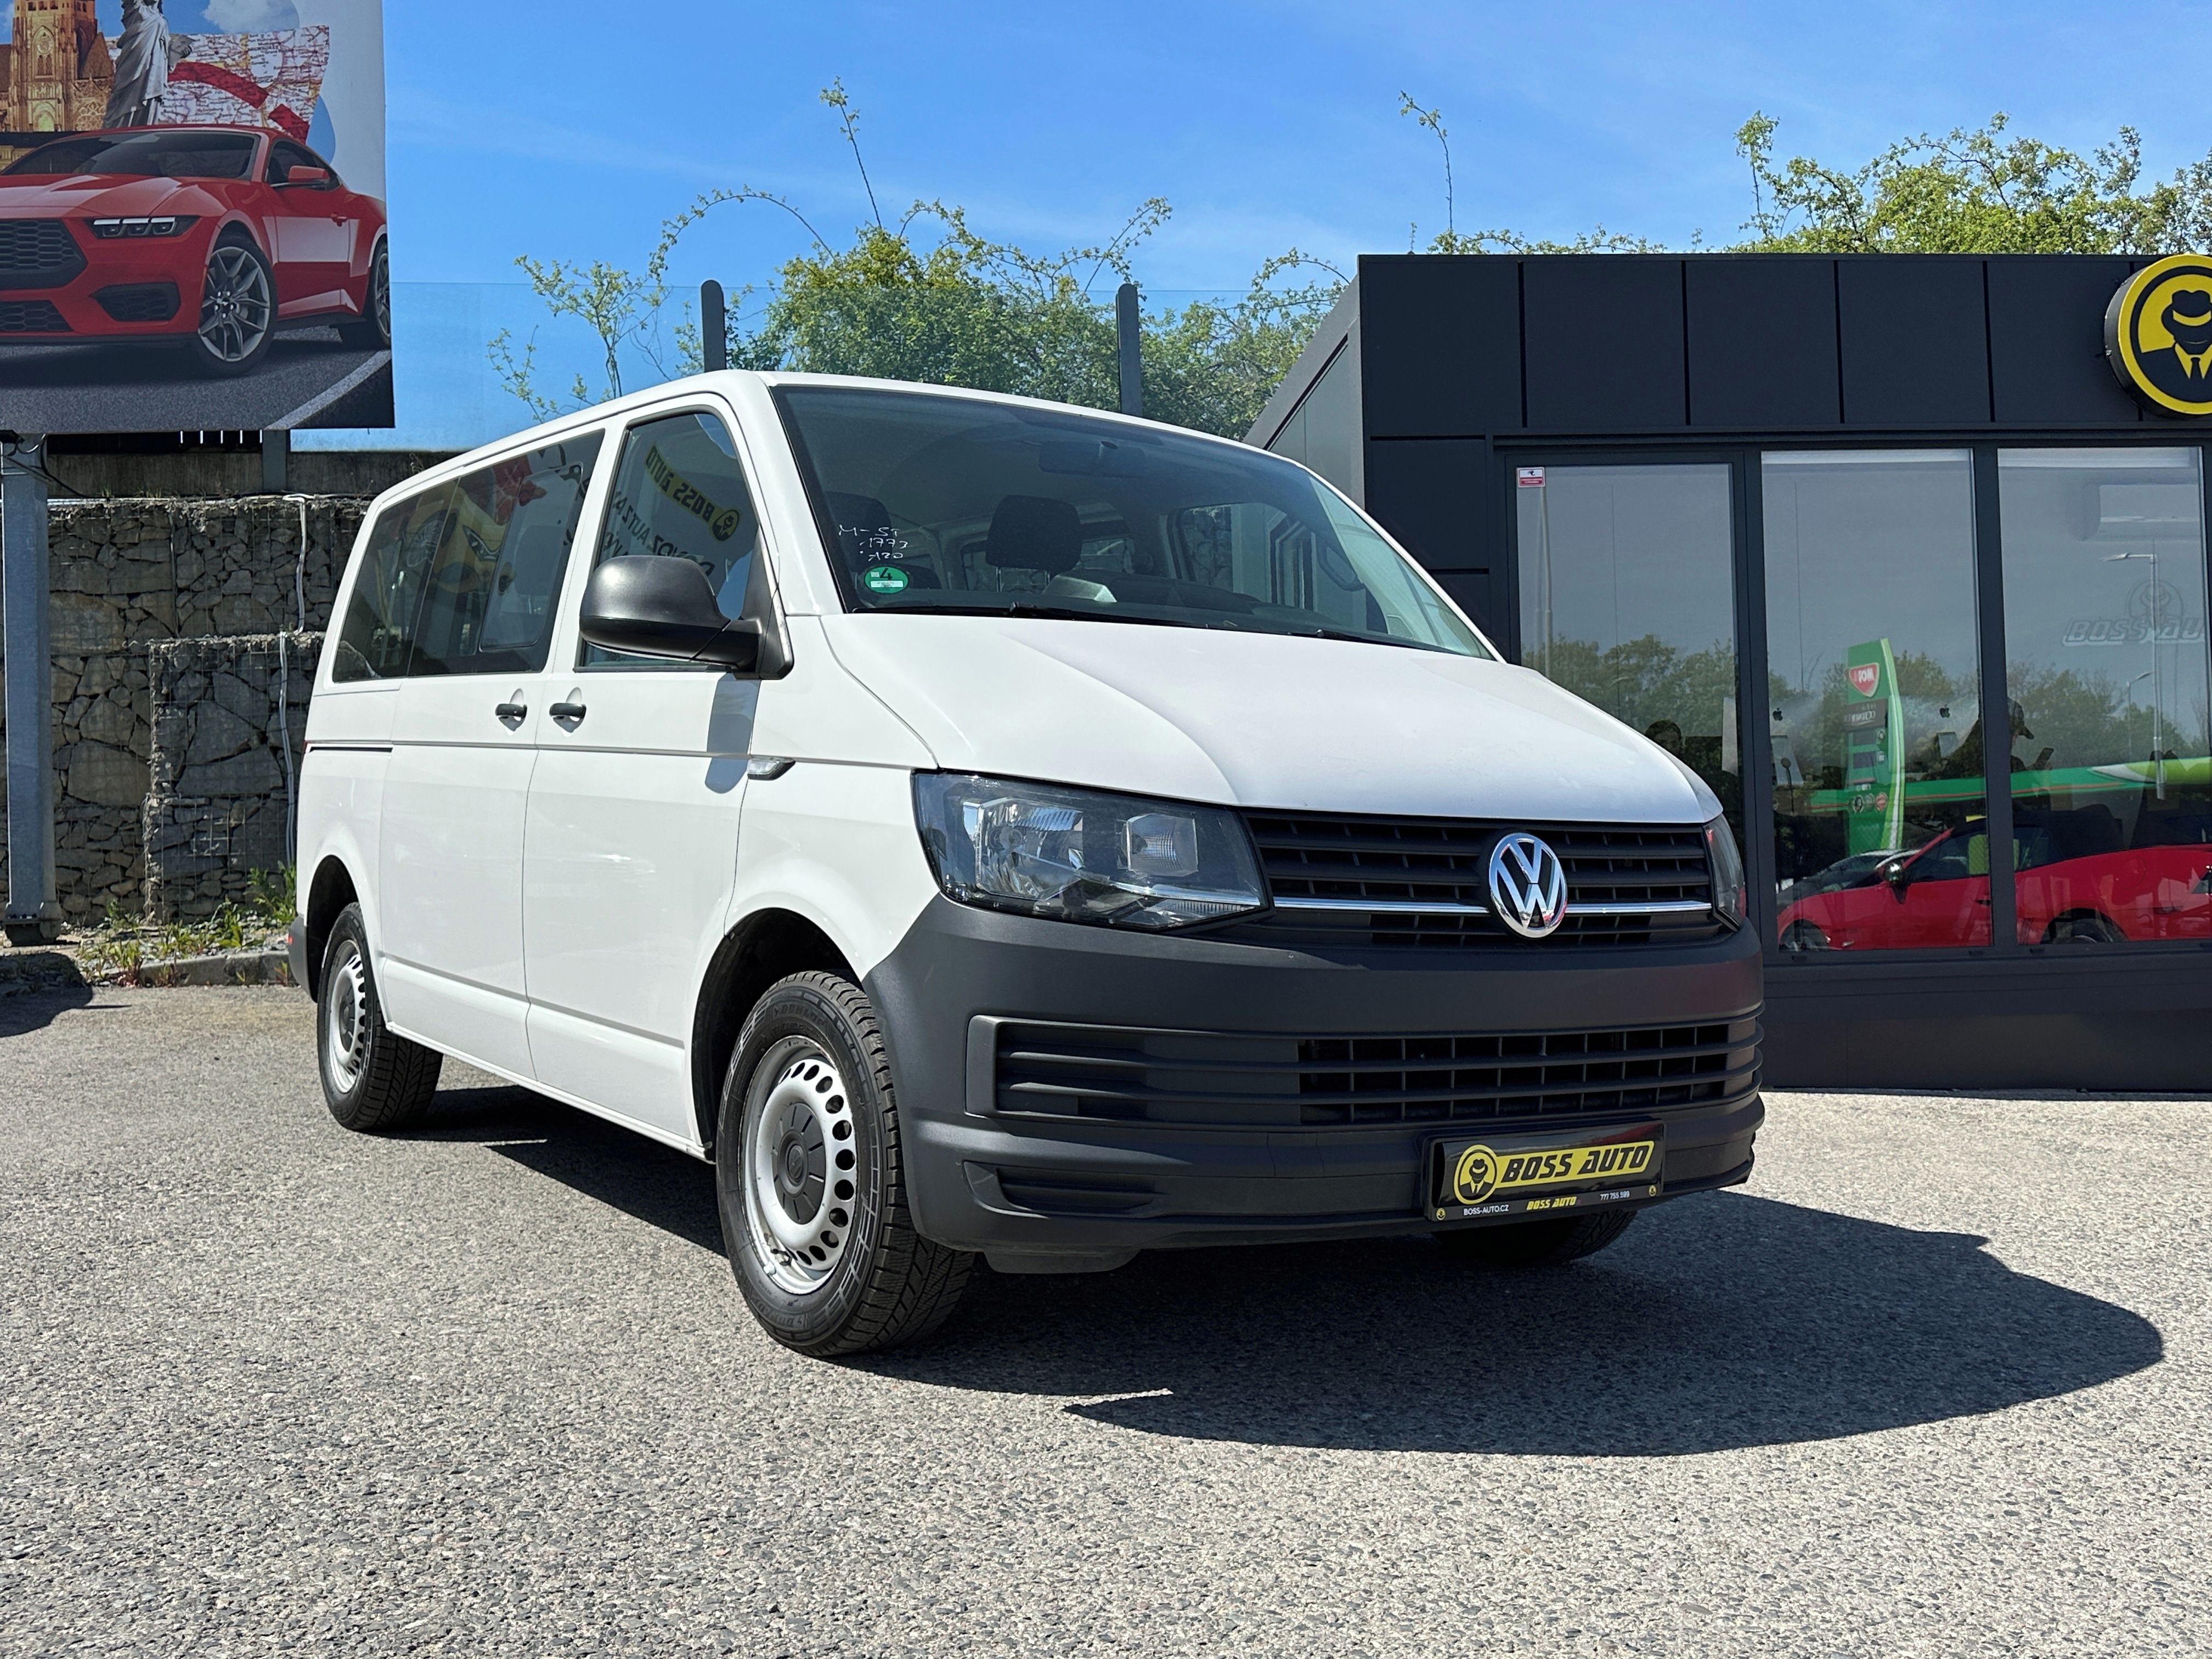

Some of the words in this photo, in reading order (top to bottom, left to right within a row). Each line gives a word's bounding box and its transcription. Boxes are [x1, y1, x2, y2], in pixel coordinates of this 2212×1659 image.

[879, 567, 893, 580] 4
[1500, 1153, 1573, 1183] BOSS
[1577, 1145, 1650, 1175] AUTO
[1463, 1204, 1509, 1216] BOSS-AUTO.CZ
[1526, 1198, 1551, 1211] BOSS
[1552, 1197, 1577, 1208] AUTO
